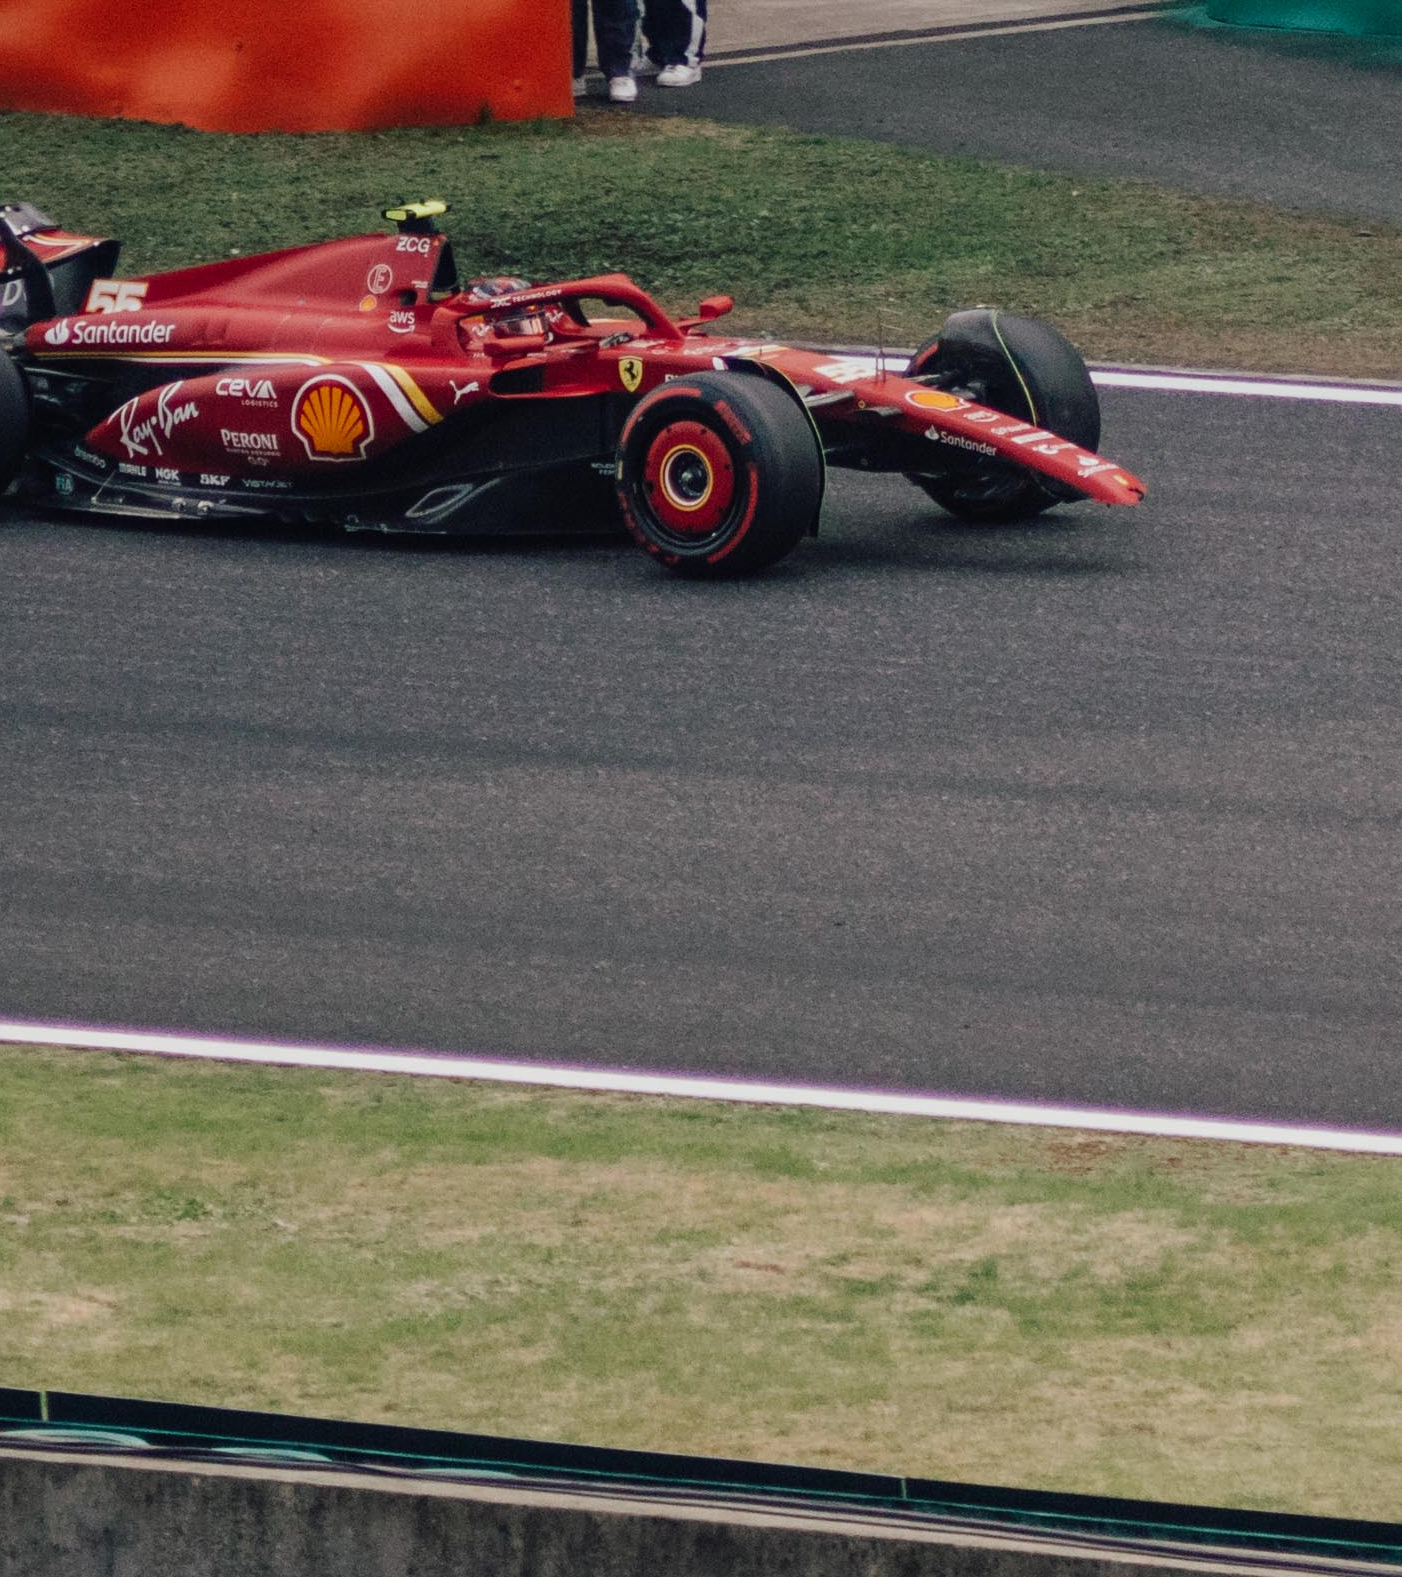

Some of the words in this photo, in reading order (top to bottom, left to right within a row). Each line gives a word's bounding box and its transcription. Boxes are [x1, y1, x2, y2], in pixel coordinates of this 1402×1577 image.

[395, 236, 431, 253] ZCG
[85, 278, 149, 314] 55
[512, 289, 563, 303] TECHNOLOGY
[389, 310, 416, 325] aws
[71, 320, 176, 344] Santander
[240, 399, 280, 408] LOGISTICS
[219, 428, 280, 451] PERONI
[940, 431, 998, 458] Santander
[154, 467, 180, 482] NGK
[199, 473, 231, 487] SKF
